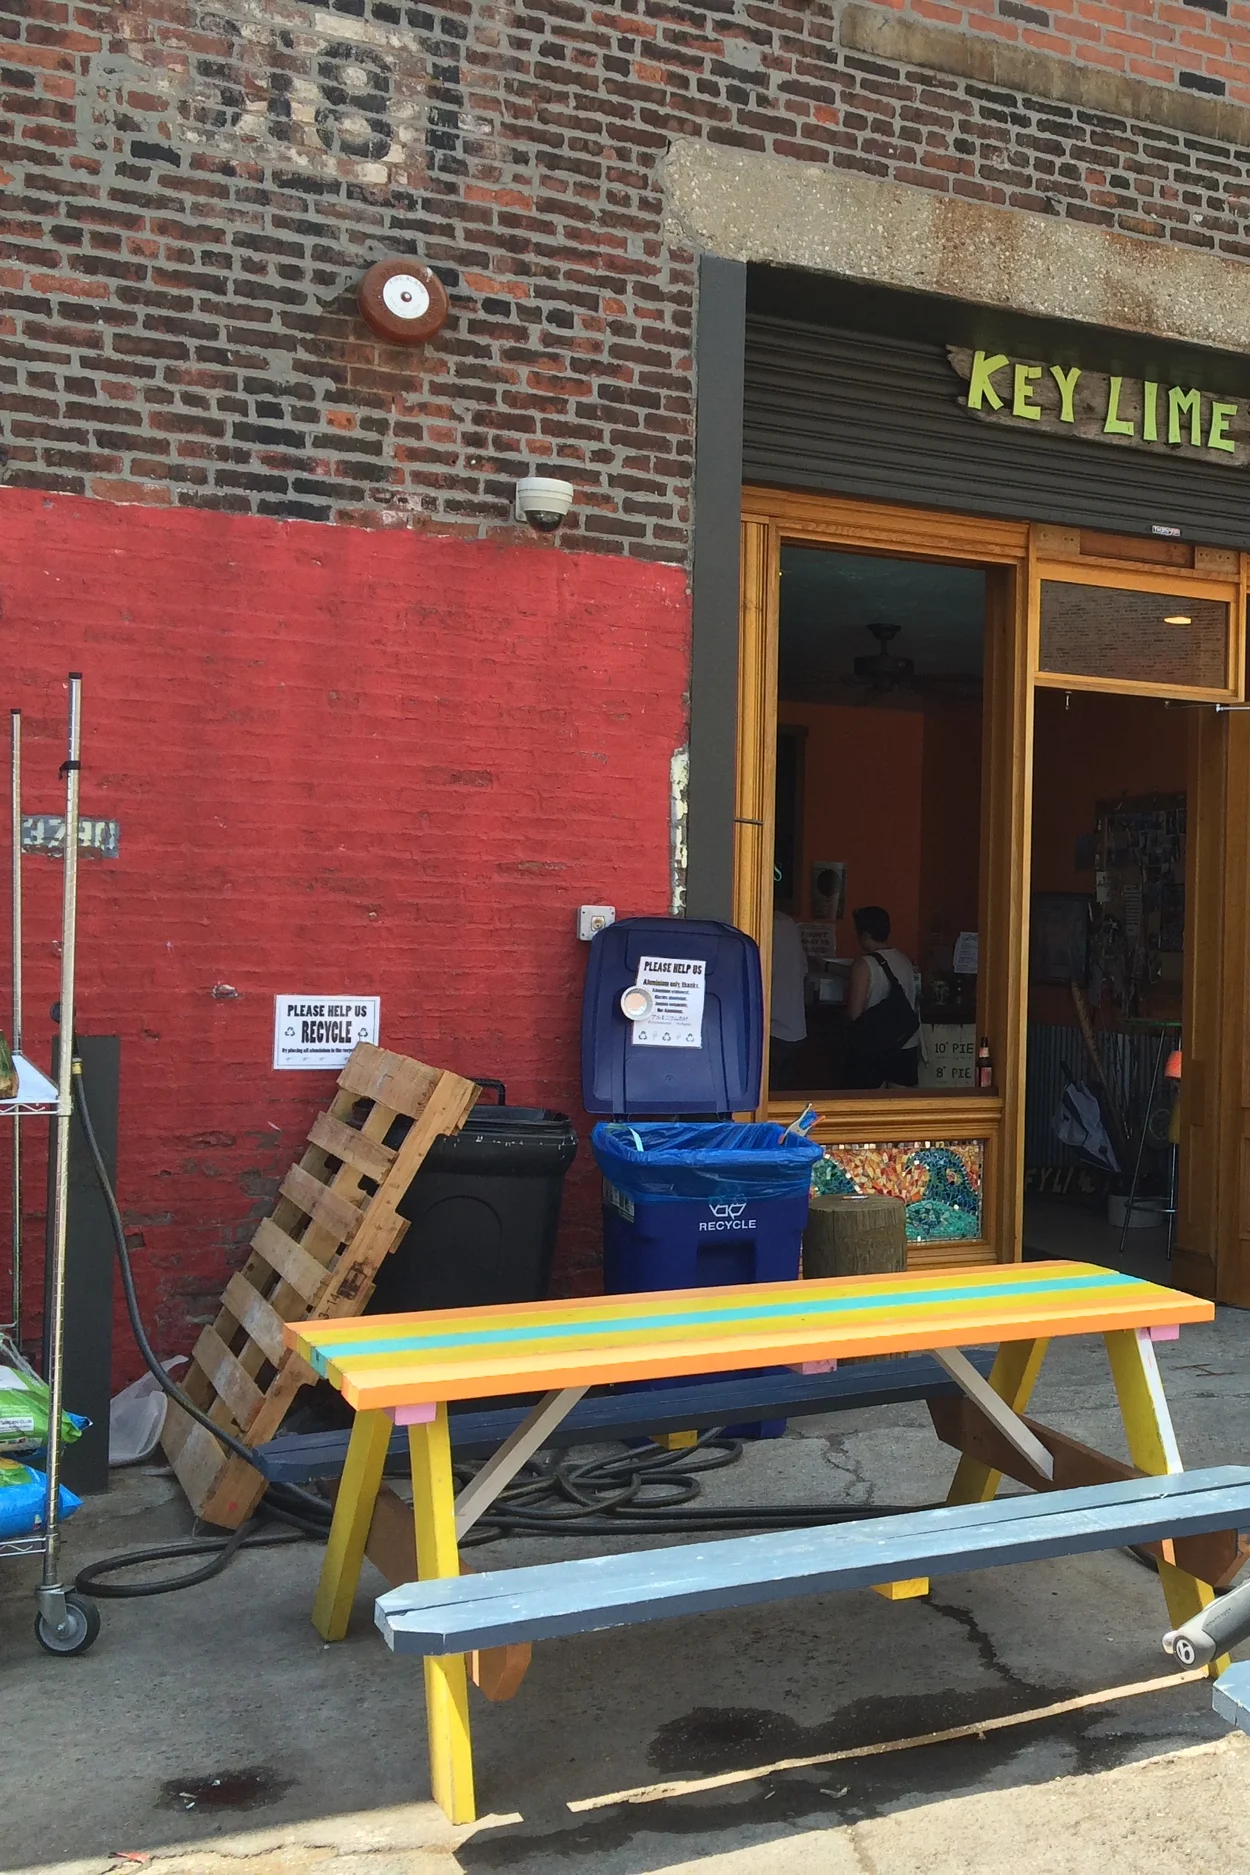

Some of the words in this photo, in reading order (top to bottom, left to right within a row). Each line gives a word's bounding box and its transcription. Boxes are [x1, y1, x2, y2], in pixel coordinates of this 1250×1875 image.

[967, 350, 1083, 424] KEY
[1103, 375, 1238, 454] LIME
[644, 961, 672, 973] PLEASE
[673, 964, 691, 974] HELP
[693, 965, 702, 975] US
[287, 1004, 325, 1017] PLEASE
[327, 1005, 352, 1017] HELP
[354, 1006, 367, 1017] US
[301, 1020, 352, 1044] RECYCLE
[952, 1042, 974, 1054] PIE
[951, 1067, 972, 1079] PIE
[699, 1219, 757, 1232] RECYCLE
